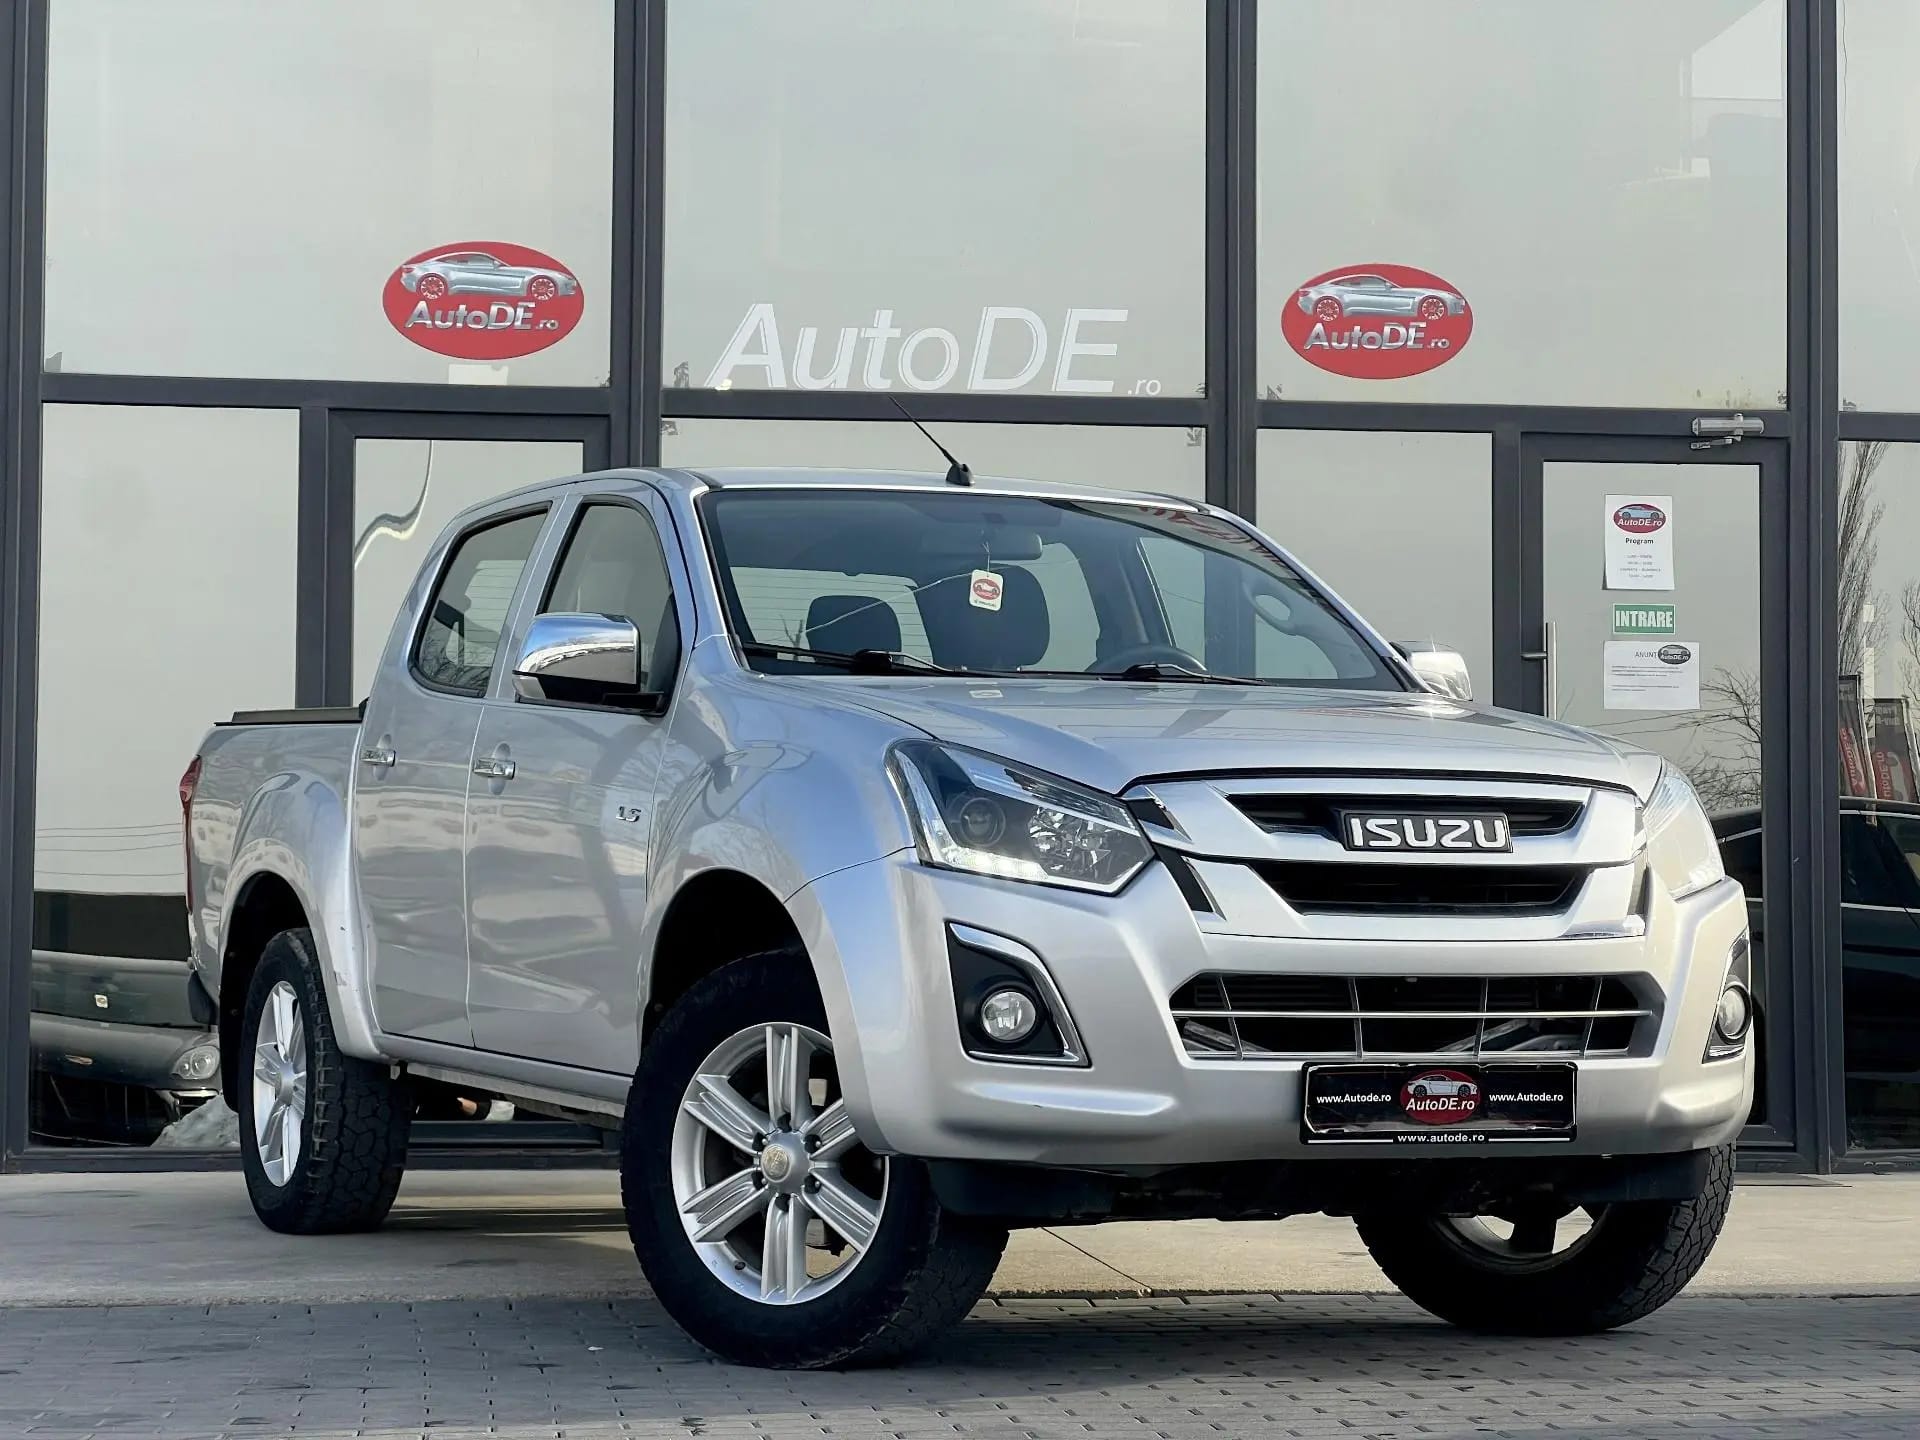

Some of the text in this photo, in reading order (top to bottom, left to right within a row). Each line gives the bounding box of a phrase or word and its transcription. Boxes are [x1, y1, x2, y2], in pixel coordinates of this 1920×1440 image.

[1625, 537, 1654, 545] Program
[1615, 610, 1673, 628] INTRARE
[1350, 818, 1506, 848] ISUZU
[1316, 1093, 1392, 1104] www.Autode.ro
[1488, 1092, 1564, 1102] www.Autode.ro
[1406, 1097, 1476, 1111] AutoDE.ro
[1397, 1133, 1485, 1143] www.autode.ro
